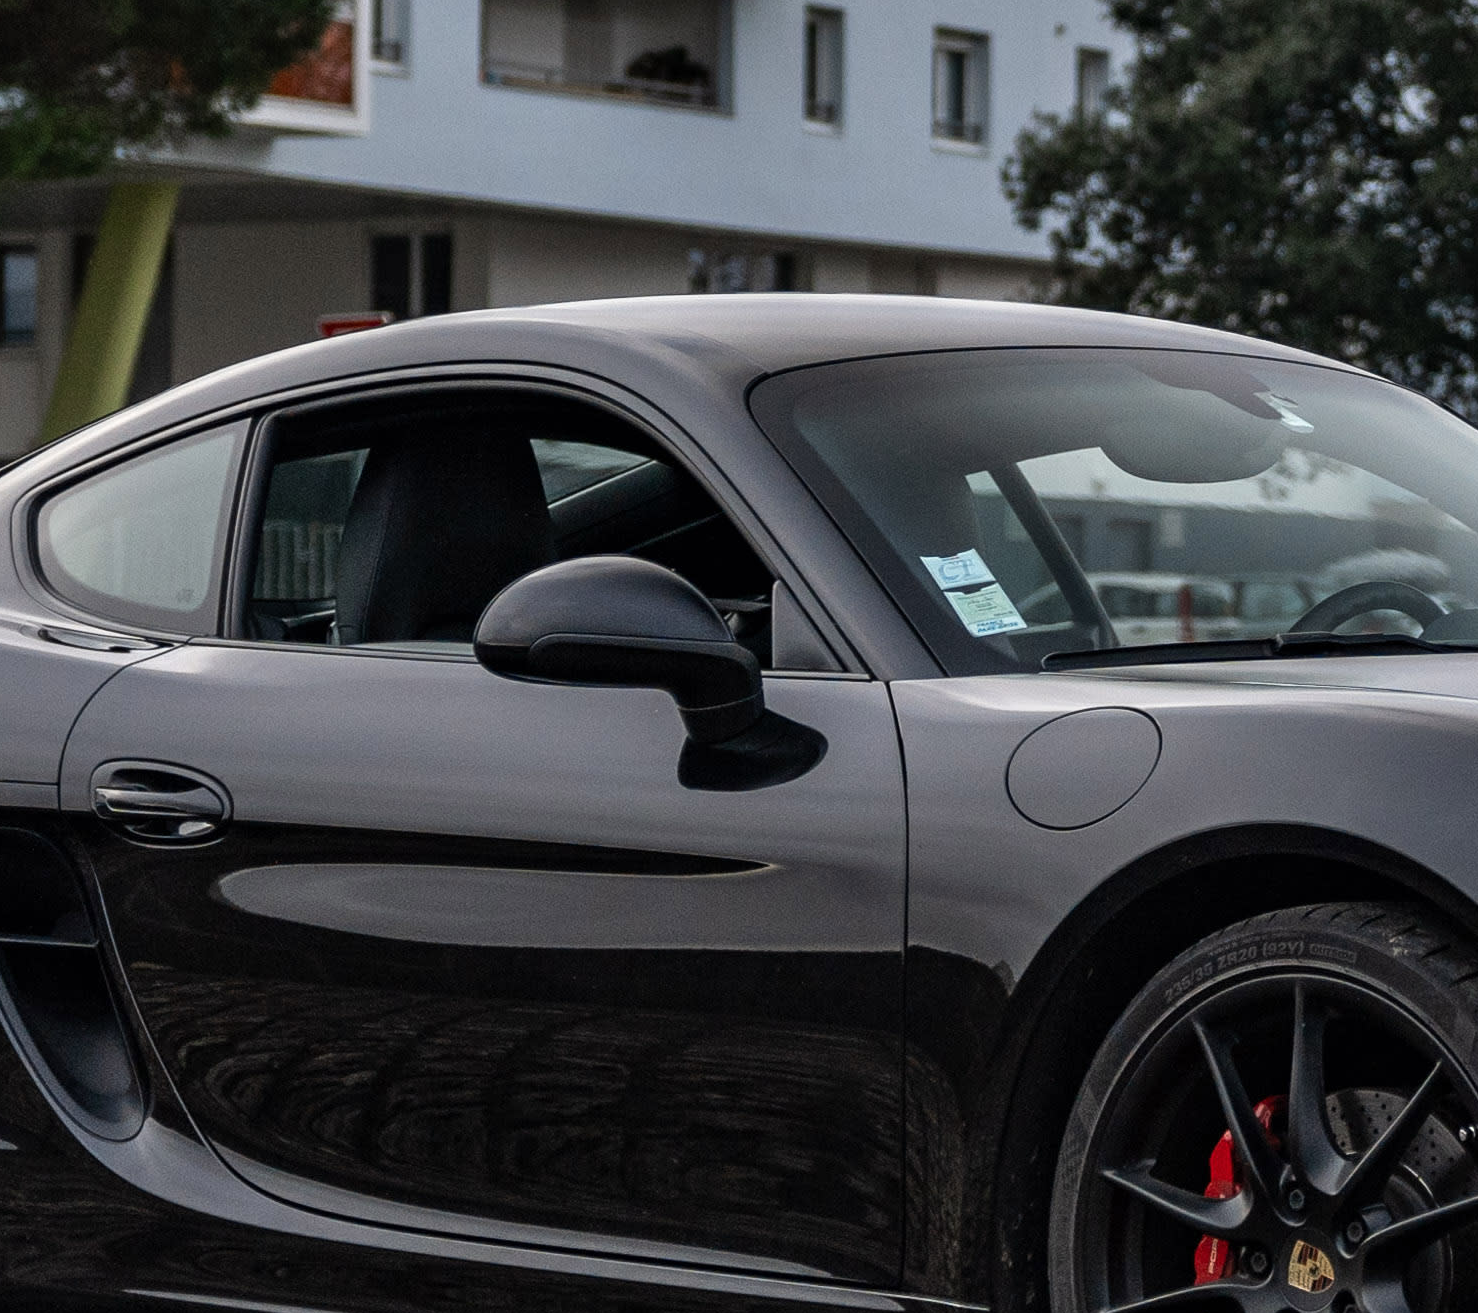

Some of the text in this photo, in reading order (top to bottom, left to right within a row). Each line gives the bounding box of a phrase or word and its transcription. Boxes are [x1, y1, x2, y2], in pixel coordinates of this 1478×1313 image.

[1164, 962, 1213, 1004] 235/35
[1217, 946, 1257, 971] ZR20
[1262, 941, 1305, 957] (92Y)
